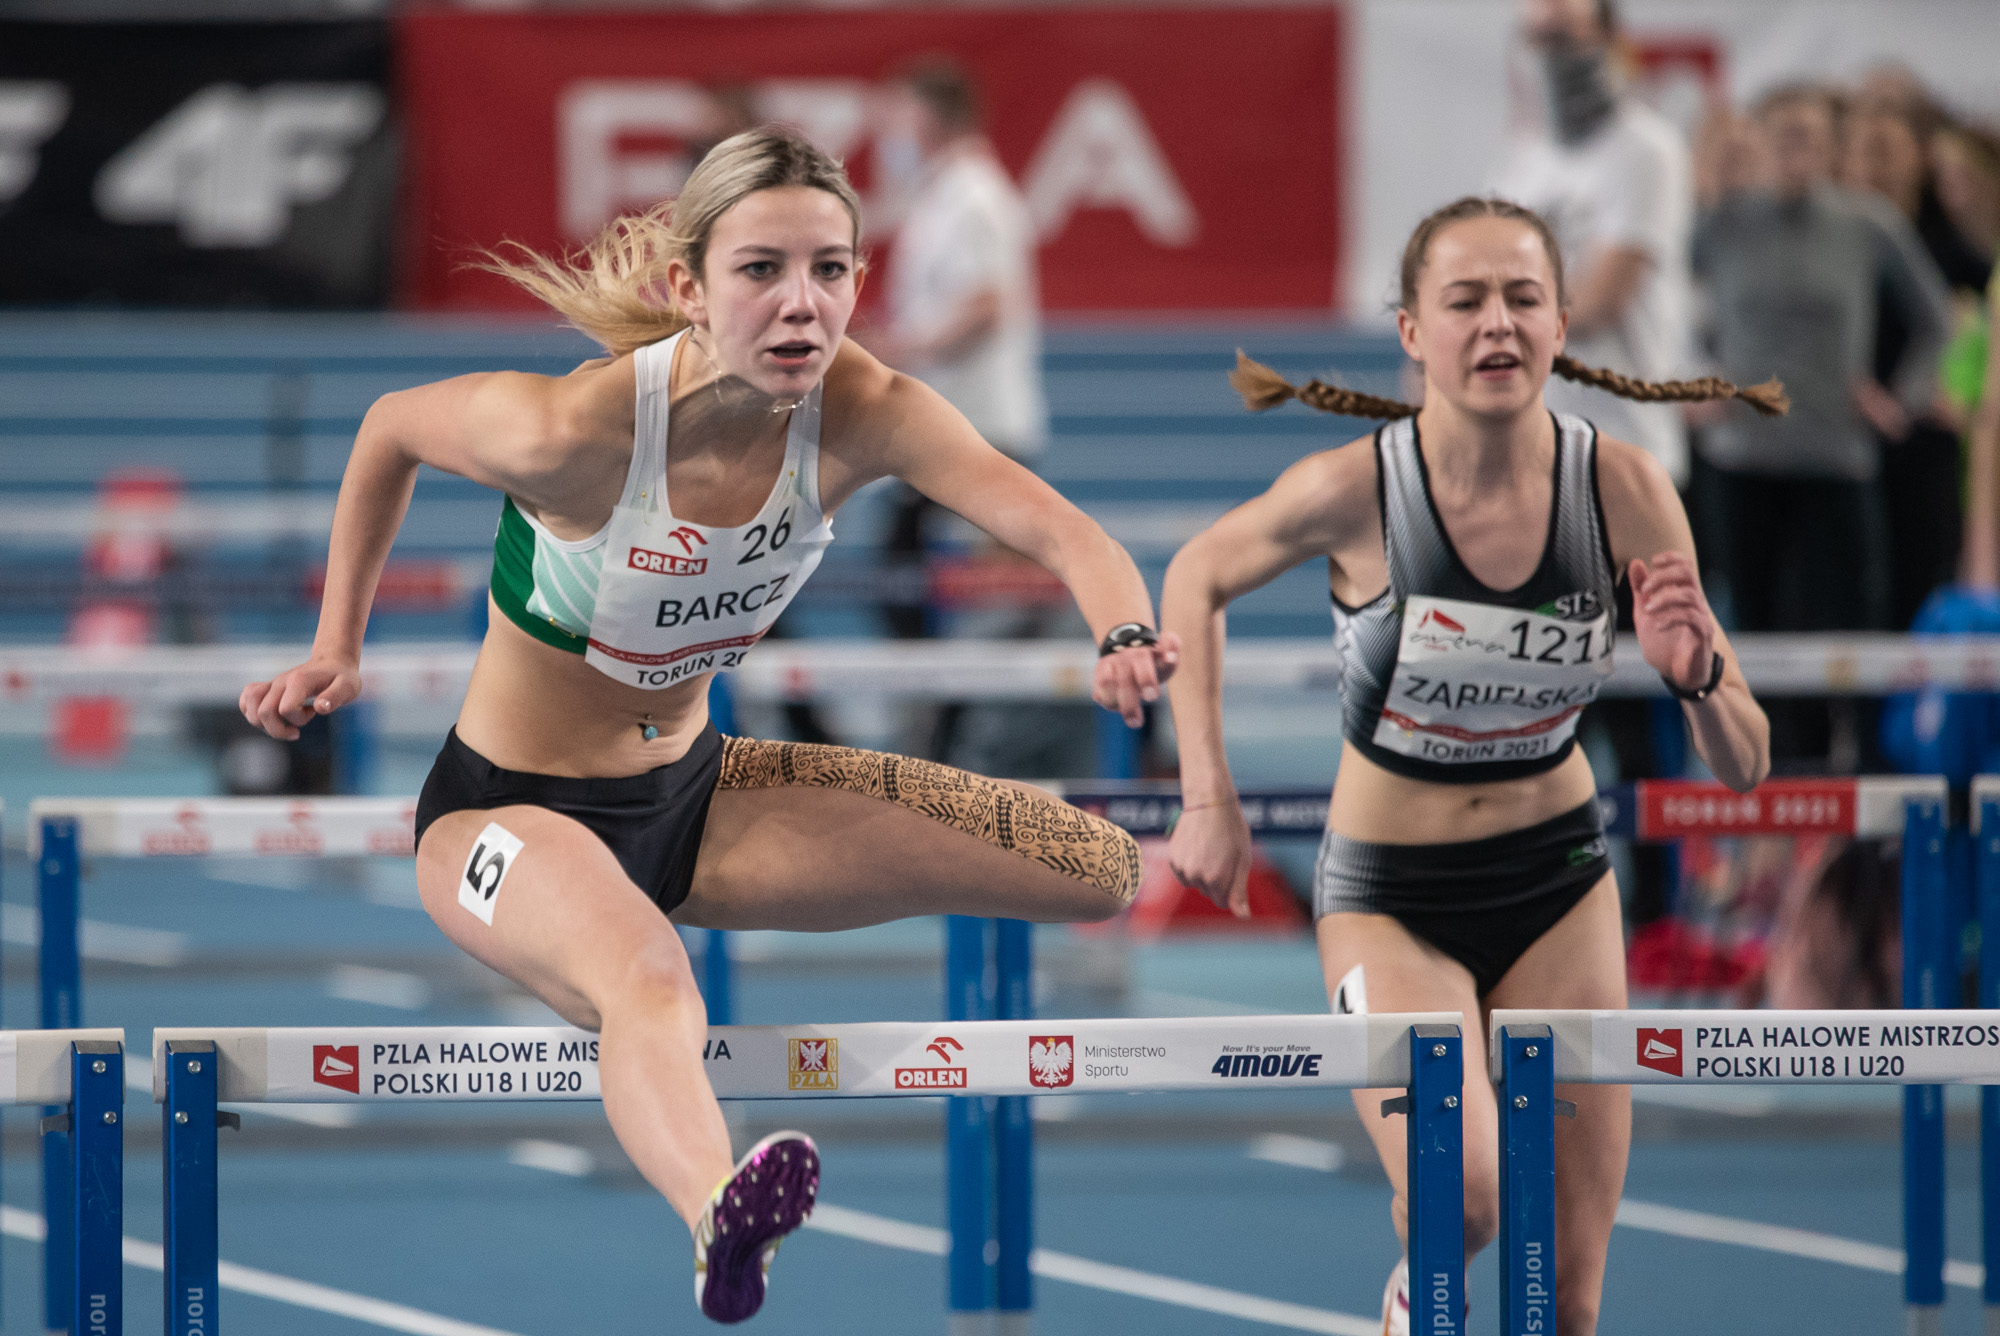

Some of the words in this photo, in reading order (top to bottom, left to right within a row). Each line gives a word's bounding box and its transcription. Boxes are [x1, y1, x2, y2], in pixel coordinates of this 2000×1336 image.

[97, 82, 383, 246] 4F
[737, 506, 790, 565] 26
[632, 550, 704, 575] ORLEN
[655, 573, 790, 628] BARCZ
[637, 651, 715, 686] TORUŃ
[1503, 738, 1548, 757] 2021
[1771, 794, 1841, 826] 2021
[466, 843, 505, 901] 5
[1696, 1027, 1754, 1048] PZLA
[1763, 1026, 1870, 1048] HALOWE
[1880, 1025, 2000, 1047] MISTRZOS
[373, 1044, 431, 1065] PZLA
[439, 1042, 548, 1063] HALOWE
[1085, 1045, 1166, 1059] Ministerstwo
[1222, 1045, 1243, 1053] Now
[1246, 1045, 1260, 1053] It's
[1263, 1046, 1284, 1054] your
[1286, 1044, 1311, 1052] Move
[1085, 1063, 1129, 1078] Sportu
[1211, 1054, 1323, 1077] 4MOVE
[1696, 1056, 1781, 1078] POLSKI
[1790, 1056, 1836, 1078] U18
[1845, 1056, 1850, 1077] I
[1859, 1055, 1905, 1077] U20
[373, 1073, 458, 1094] POLSKI
[468, 1073, 513, 1094] U18
[522, 1072, 527, 1093] I
[536, 1070, 582, 1092] U20
[791, 1072, 836, 1088] PZLA
[898, 1070, 963, 1087] ORLEN
[1522, 1241, 1548, 1336] nordics
[1433, 1273, 1456, 1336] nordi
